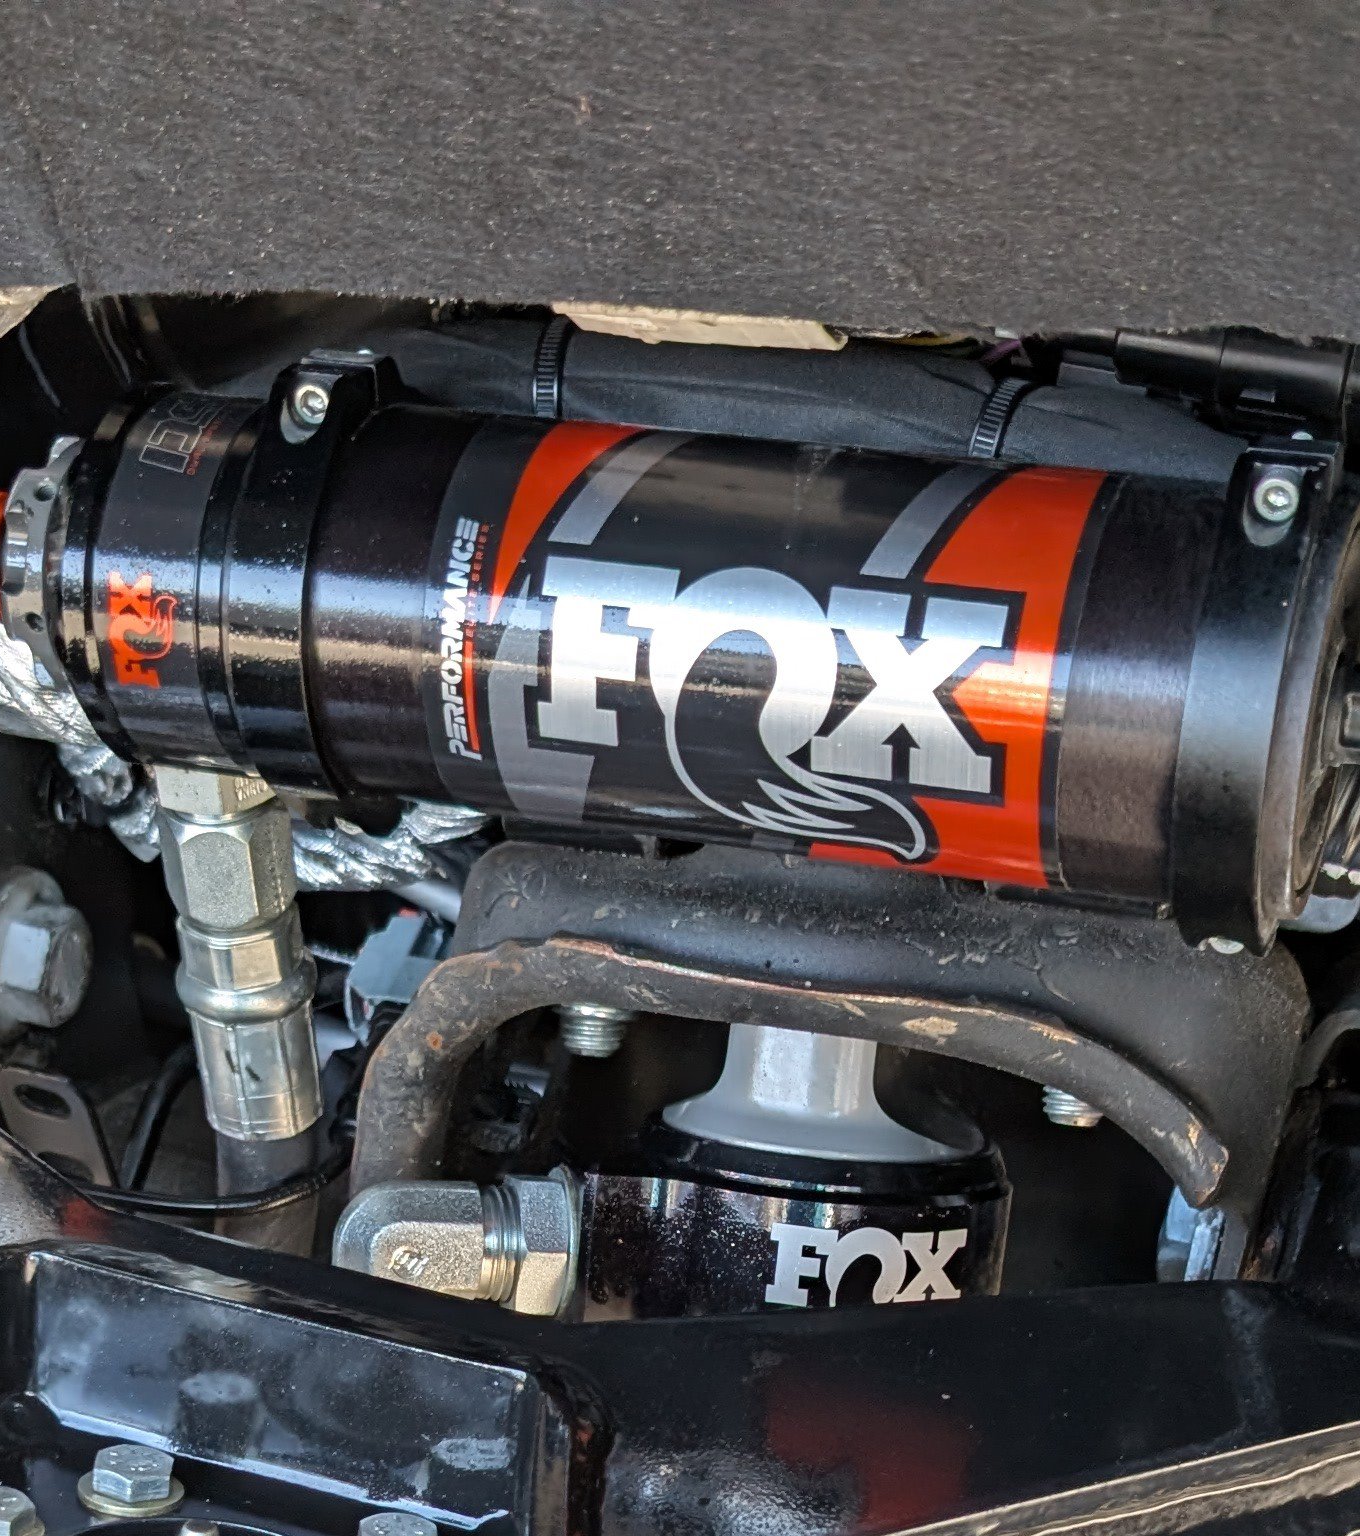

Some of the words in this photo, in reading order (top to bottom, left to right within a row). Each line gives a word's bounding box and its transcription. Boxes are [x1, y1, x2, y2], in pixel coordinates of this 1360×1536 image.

[472, 521, 490, 582] SERIES
[106, 571, 178, 689] FOX
[441, 515, 482, 760] PERFORMANCE
[537, 555, 1008, 860] FOX
[765, 1222, 968, 1307] FOX
